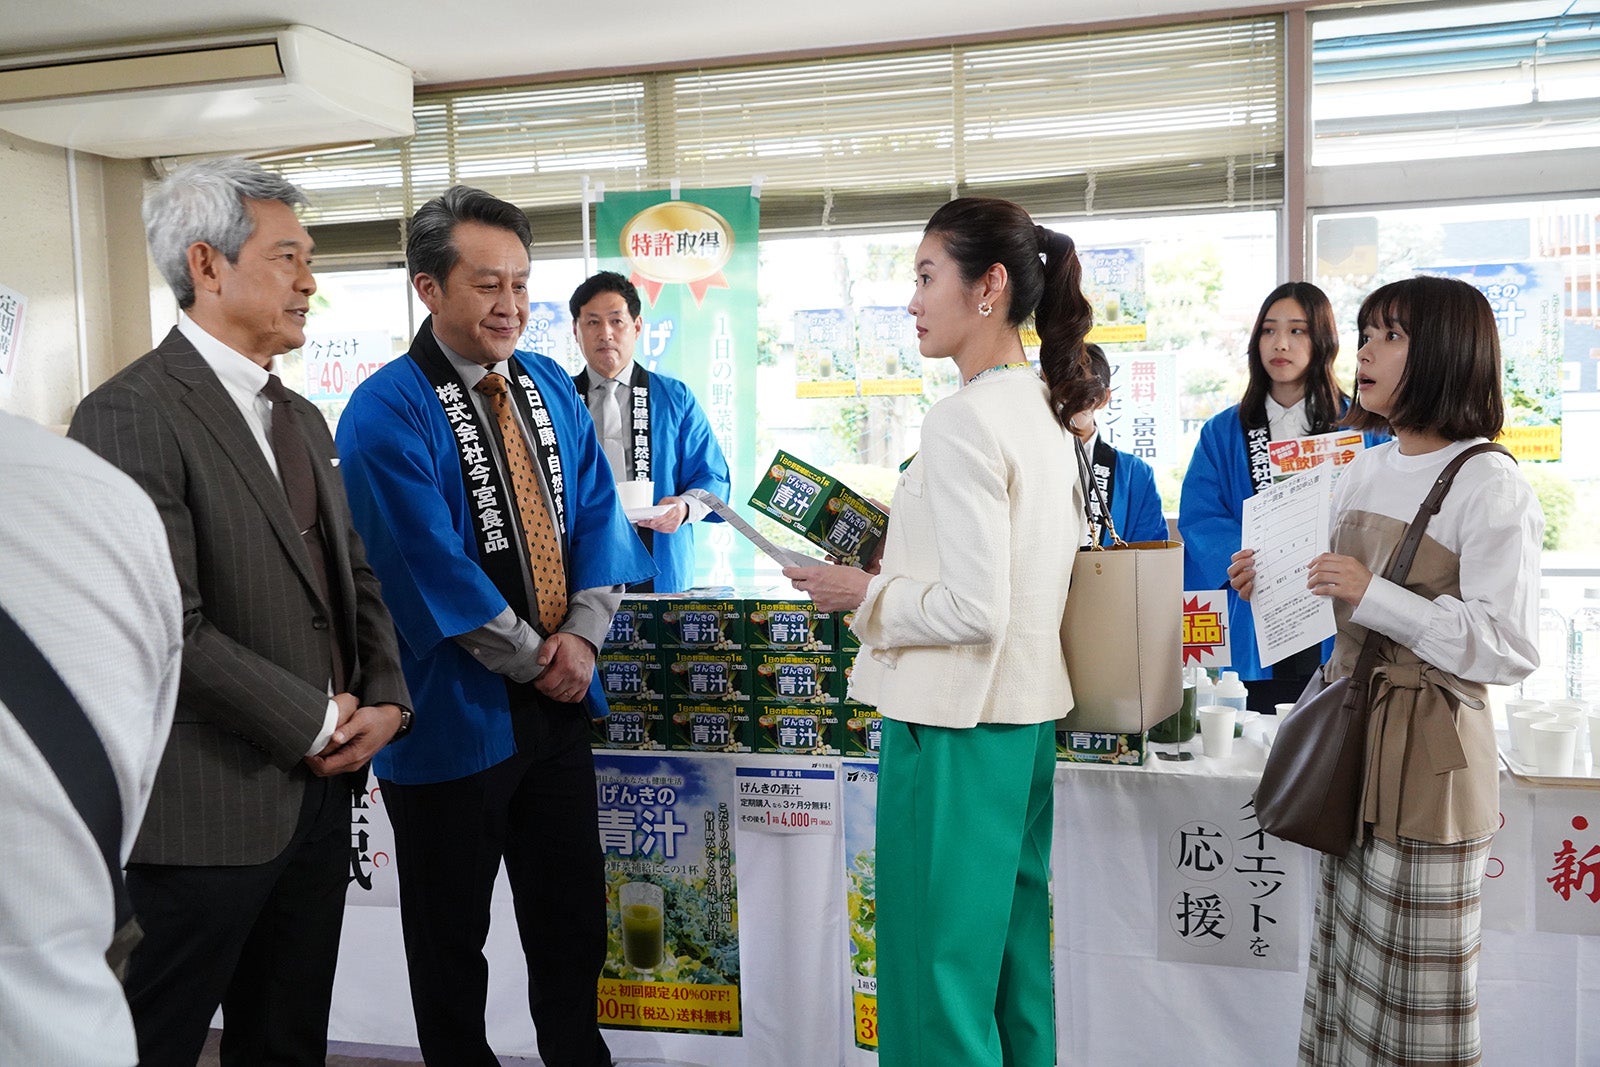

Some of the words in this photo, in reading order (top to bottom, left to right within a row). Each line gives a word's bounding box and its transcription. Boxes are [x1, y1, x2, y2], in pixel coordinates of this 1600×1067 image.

[631, 231, 721, 257] 特許取得
[1474, 284, 1519, 299] きの
[308, 339, 359, 360] 今だけ
[320, 361, 386, 394] 40%O
[435, 382, 510, 554] 株式会社今宮食品
[786, 474, 815, 496] げんきの
[772, 484, 810, 517] 青汁
[843, 509, 866, 530] げんきの
[828, 519, 860, 552] 青汁
[685, 613, 715, 622] げんきの
[774, 613, 805, 623] げんきの
[682, 623, 719, 642] 青汁
[771, 623, 809, 643] 青汁
[609, 663, 638, 672] げんきの
[694, 664, 723, 673] げんきの
[781, 666, 812, 675] げんきの
[606, 673, 642, 691] 青汁
[691, 673, 727, 692] 青汁
[778, 676, 816, 695] 青汁
[611, 714, 640, 723] げんきの
[695, 716, 725, 725] げんきの
[783, 718, 813, 727] げんきの
[608, 723, 644, 742] 青汁
[693, 725, 729, 744] 青汁
[780, 727, 817, 747] 青汁
[770, 770, 802, 778] 健康飲料
[602, 785, 676, 806] げんきの
[740, 783, 801, 795] げんきの青汁
[598, 808, 686, 857] 青汁
[1546, 839, 1600, 904] 新
[1176, 826, 1226, 940] 応援
[597, 984, 730, 1002] んと初回限定40%OFF!
[861, 1018, 879, 1040] 3
